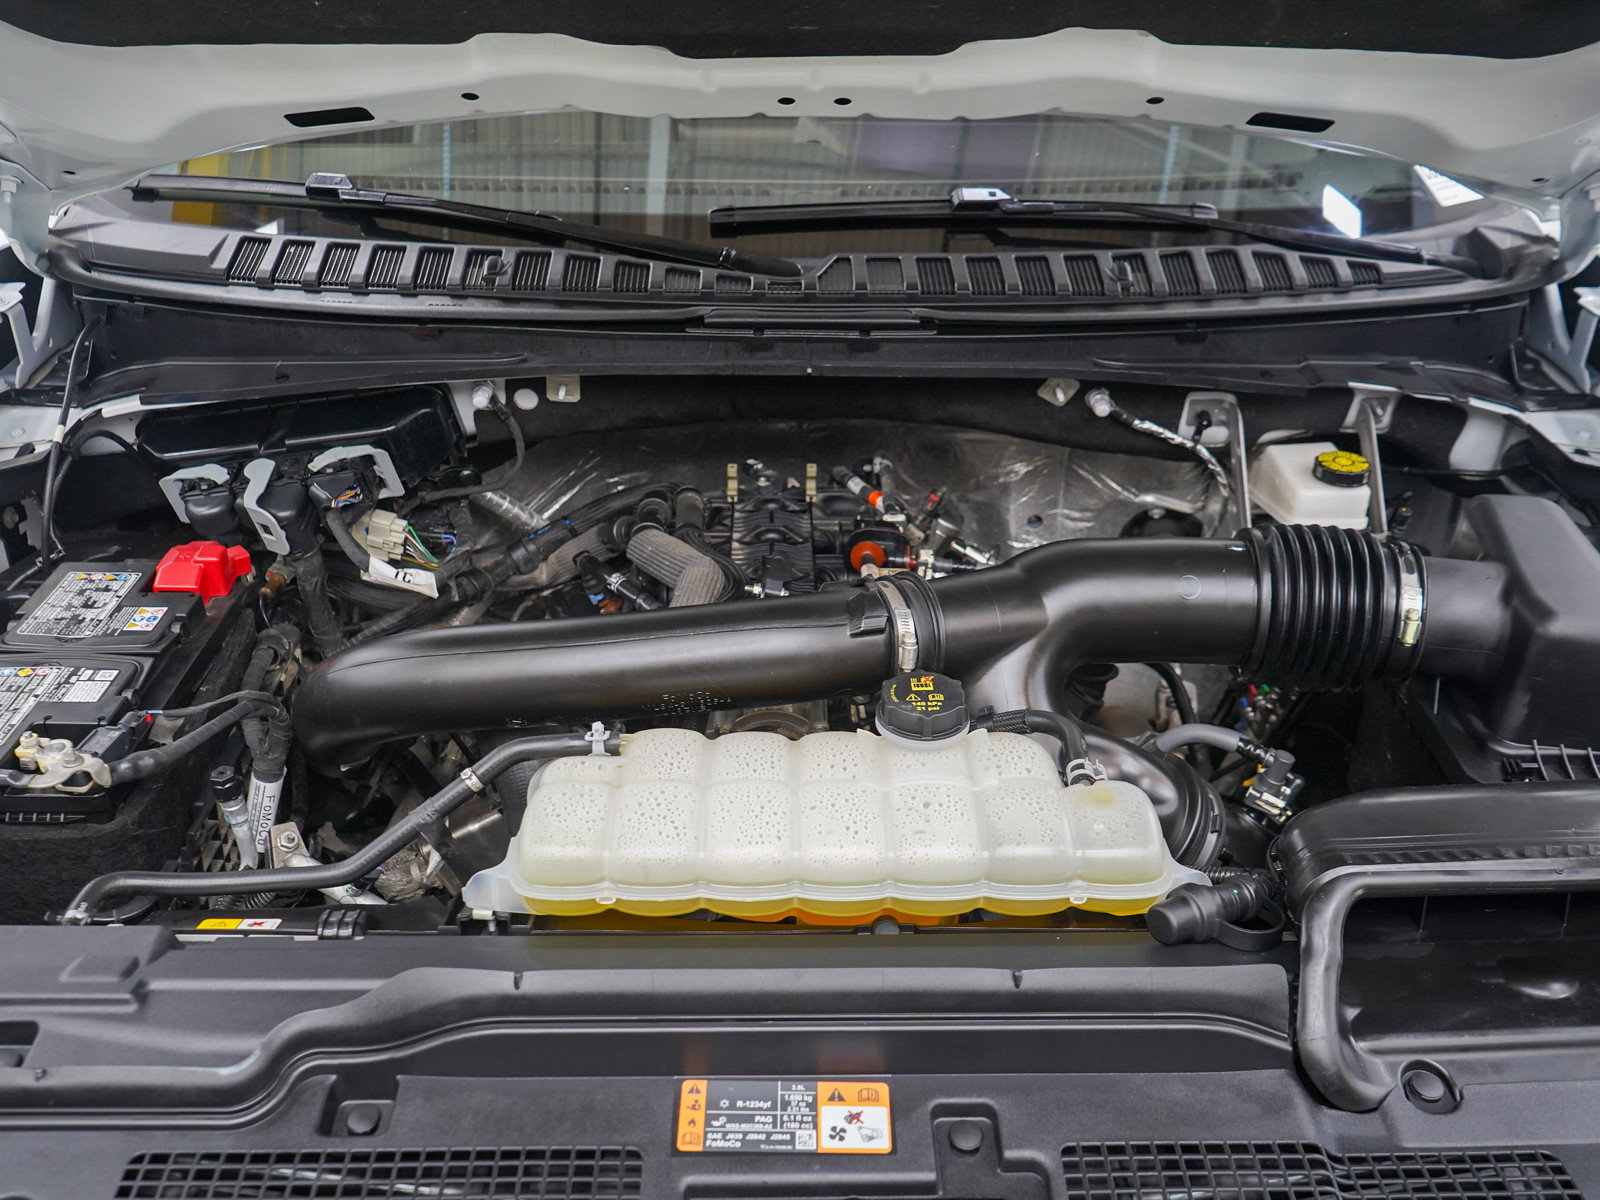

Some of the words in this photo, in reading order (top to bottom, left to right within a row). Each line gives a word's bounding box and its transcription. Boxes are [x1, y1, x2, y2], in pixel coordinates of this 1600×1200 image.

[257, 795, 276, 846] FoMoCo
[736, 1100, 772, 1110] R-1234yf
[754, 1115, 773, 1123] PAG
[706, 1132, 723, 1140] SAE
[705, 1139, 742, 1149] FoMoCo
